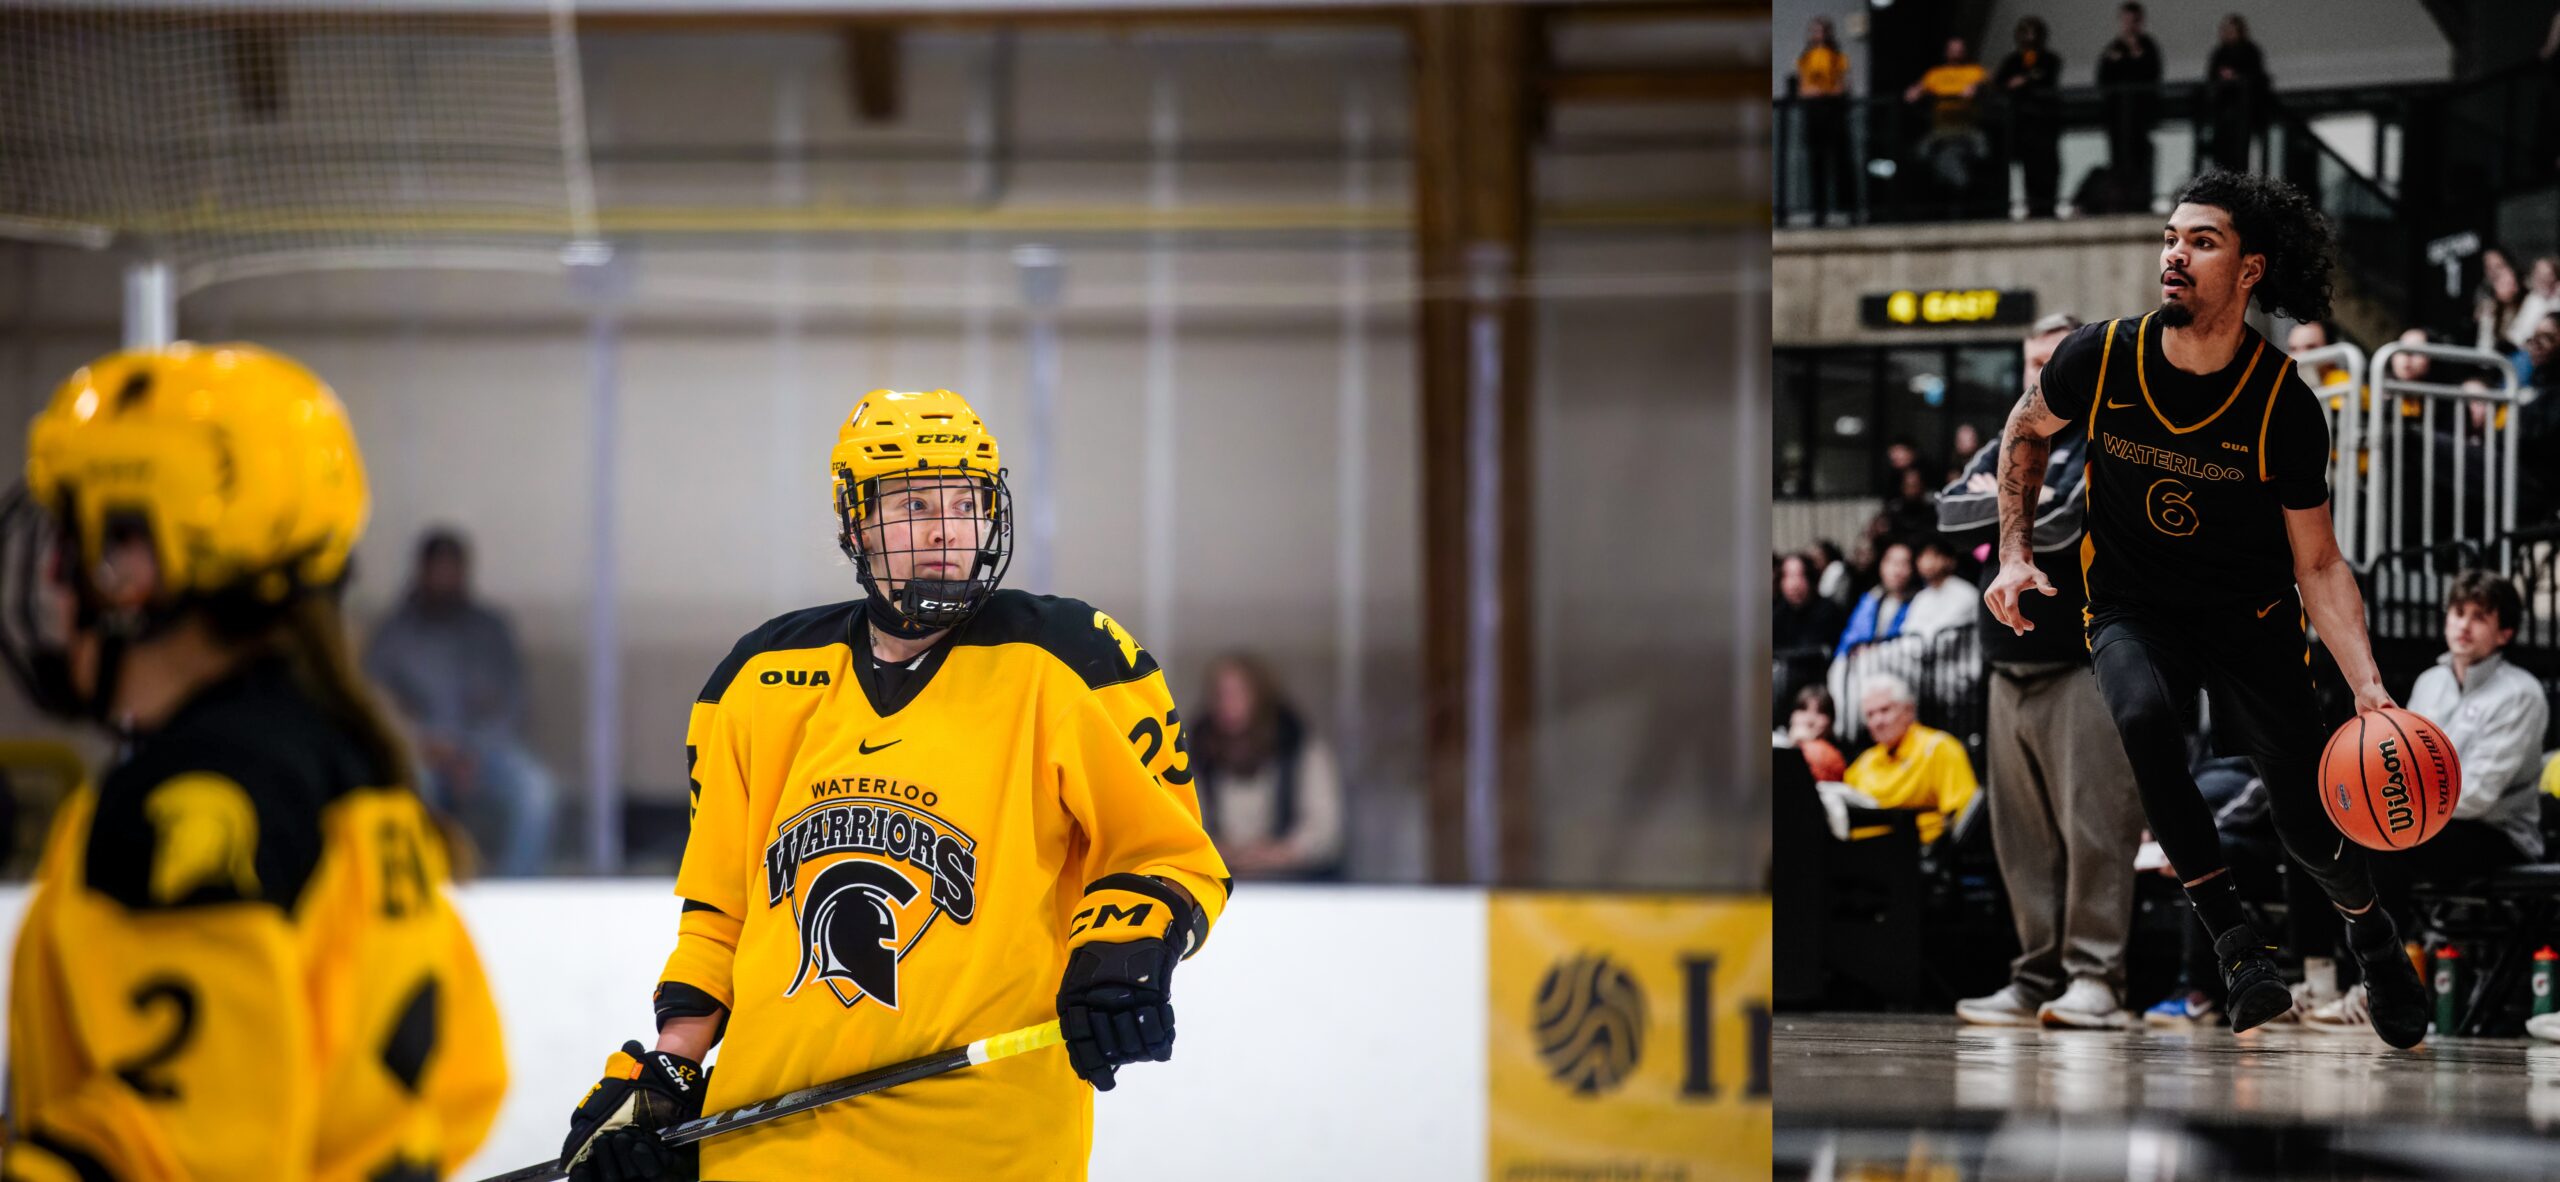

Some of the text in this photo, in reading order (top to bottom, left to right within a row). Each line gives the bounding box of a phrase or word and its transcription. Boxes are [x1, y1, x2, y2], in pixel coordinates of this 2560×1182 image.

[916, 434, 967, 443] CCM
[2103, 432, 2244, 482] WATERLOO
[2221, 441, 2249, 453] OUA
[2146, 478, 2199, 537] 6
[760, 670, 831, 687] OUA
[1128, 707, 1195, 787] 23
[811, 778, 938, 807] WATERLOO
[2378, 736, 2417, 835] Wilson
[764, 805, 977, 926] WARRIORS
[114, 970, 204, 1101] 2
[658, 1054, 691, 1092] CCM
